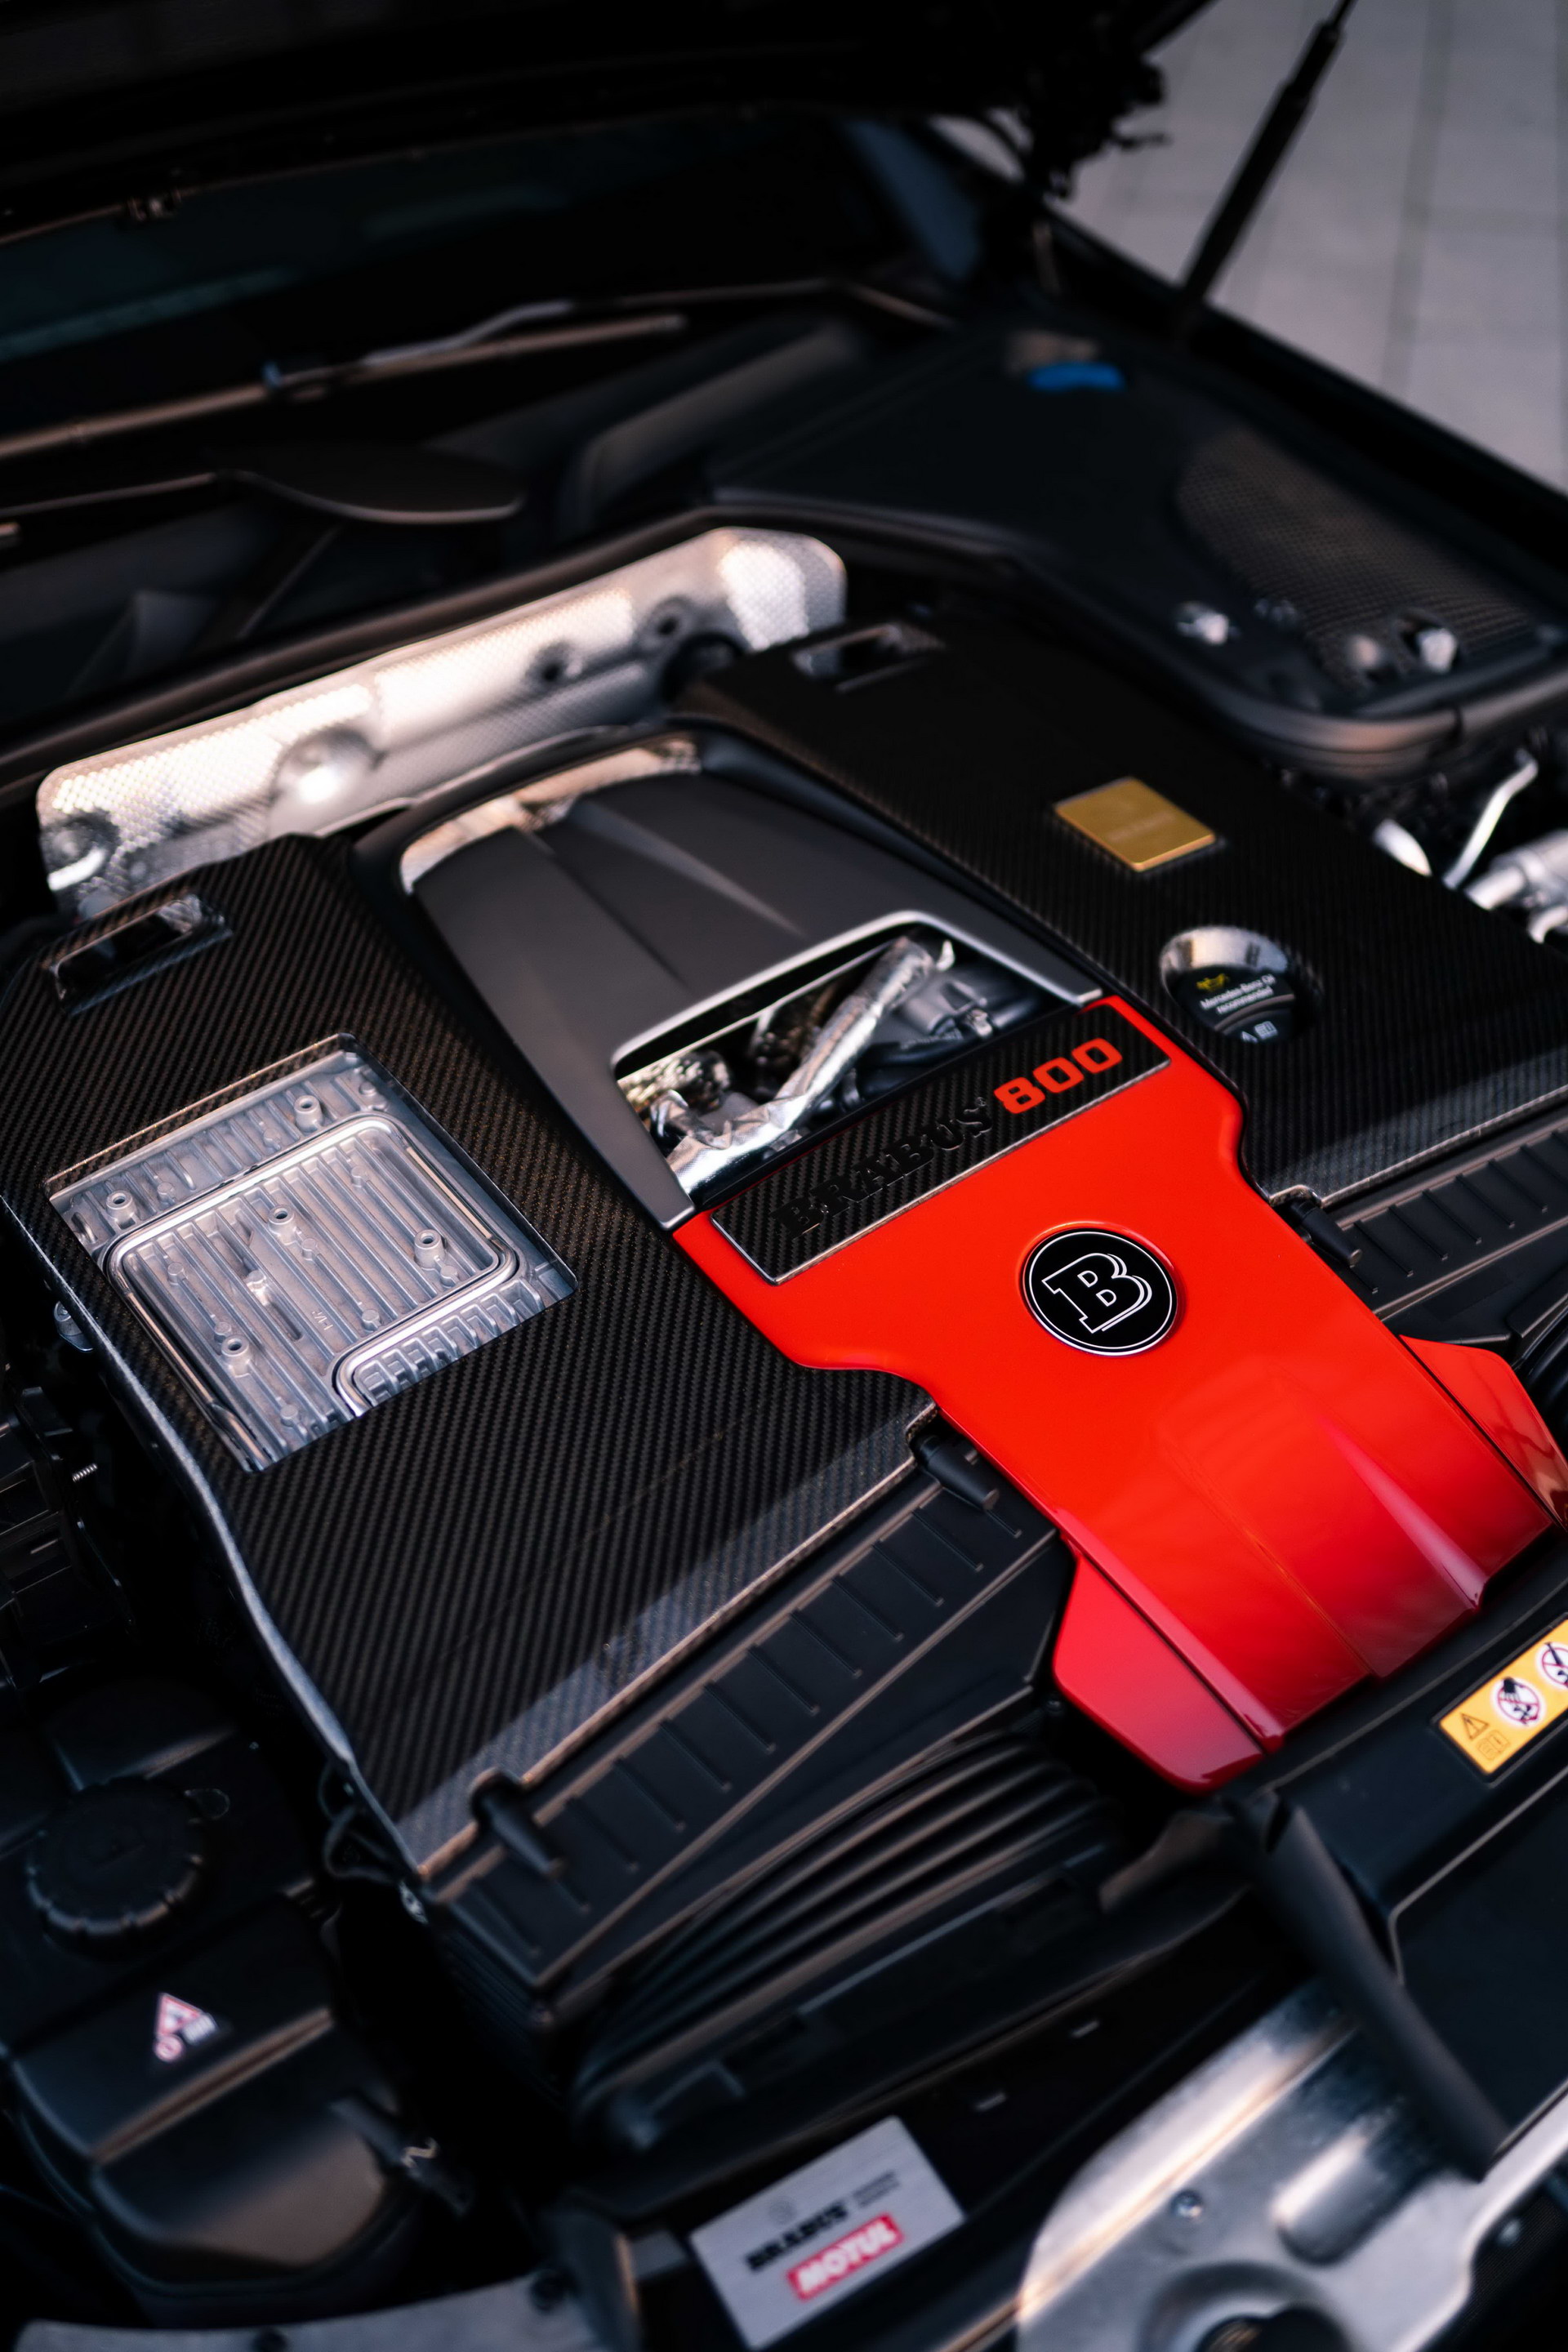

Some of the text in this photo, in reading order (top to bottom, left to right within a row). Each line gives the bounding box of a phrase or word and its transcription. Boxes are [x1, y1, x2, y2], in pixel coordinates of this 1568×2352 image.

[770, 1038, 1123, 1241] BRABUS 800
[1041, 1252, 1153, 1334] B
[795, 2220, 898, 2293] MOTUL
